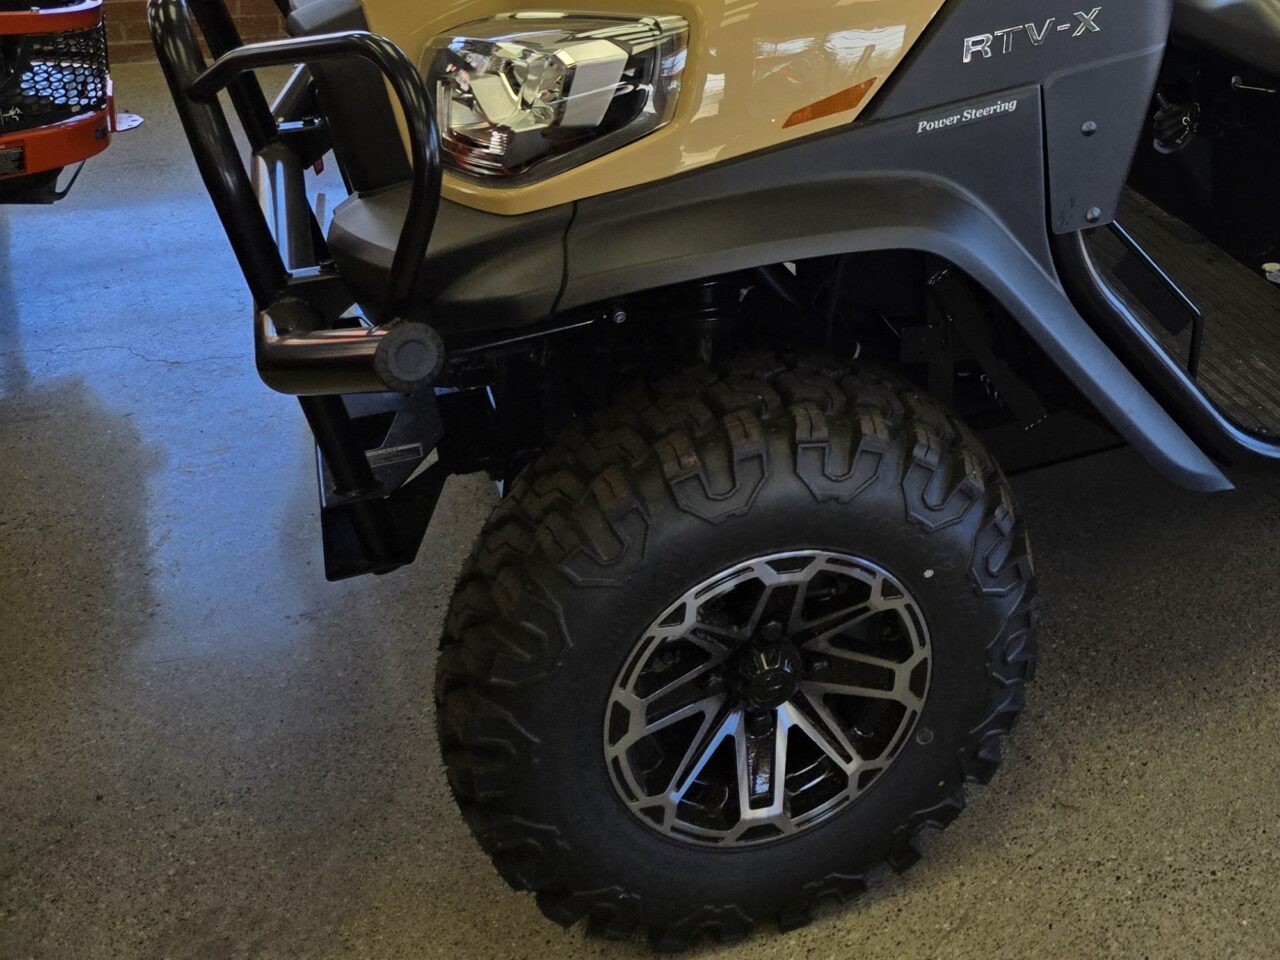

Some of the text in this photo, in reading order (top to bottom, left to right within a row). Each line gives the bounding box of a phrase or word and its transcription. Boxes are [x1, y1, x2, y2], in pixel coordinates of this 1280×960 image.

[962, 6, 1102, 63] RTV-X
[916, 99, 1018, 134] Power Steering
